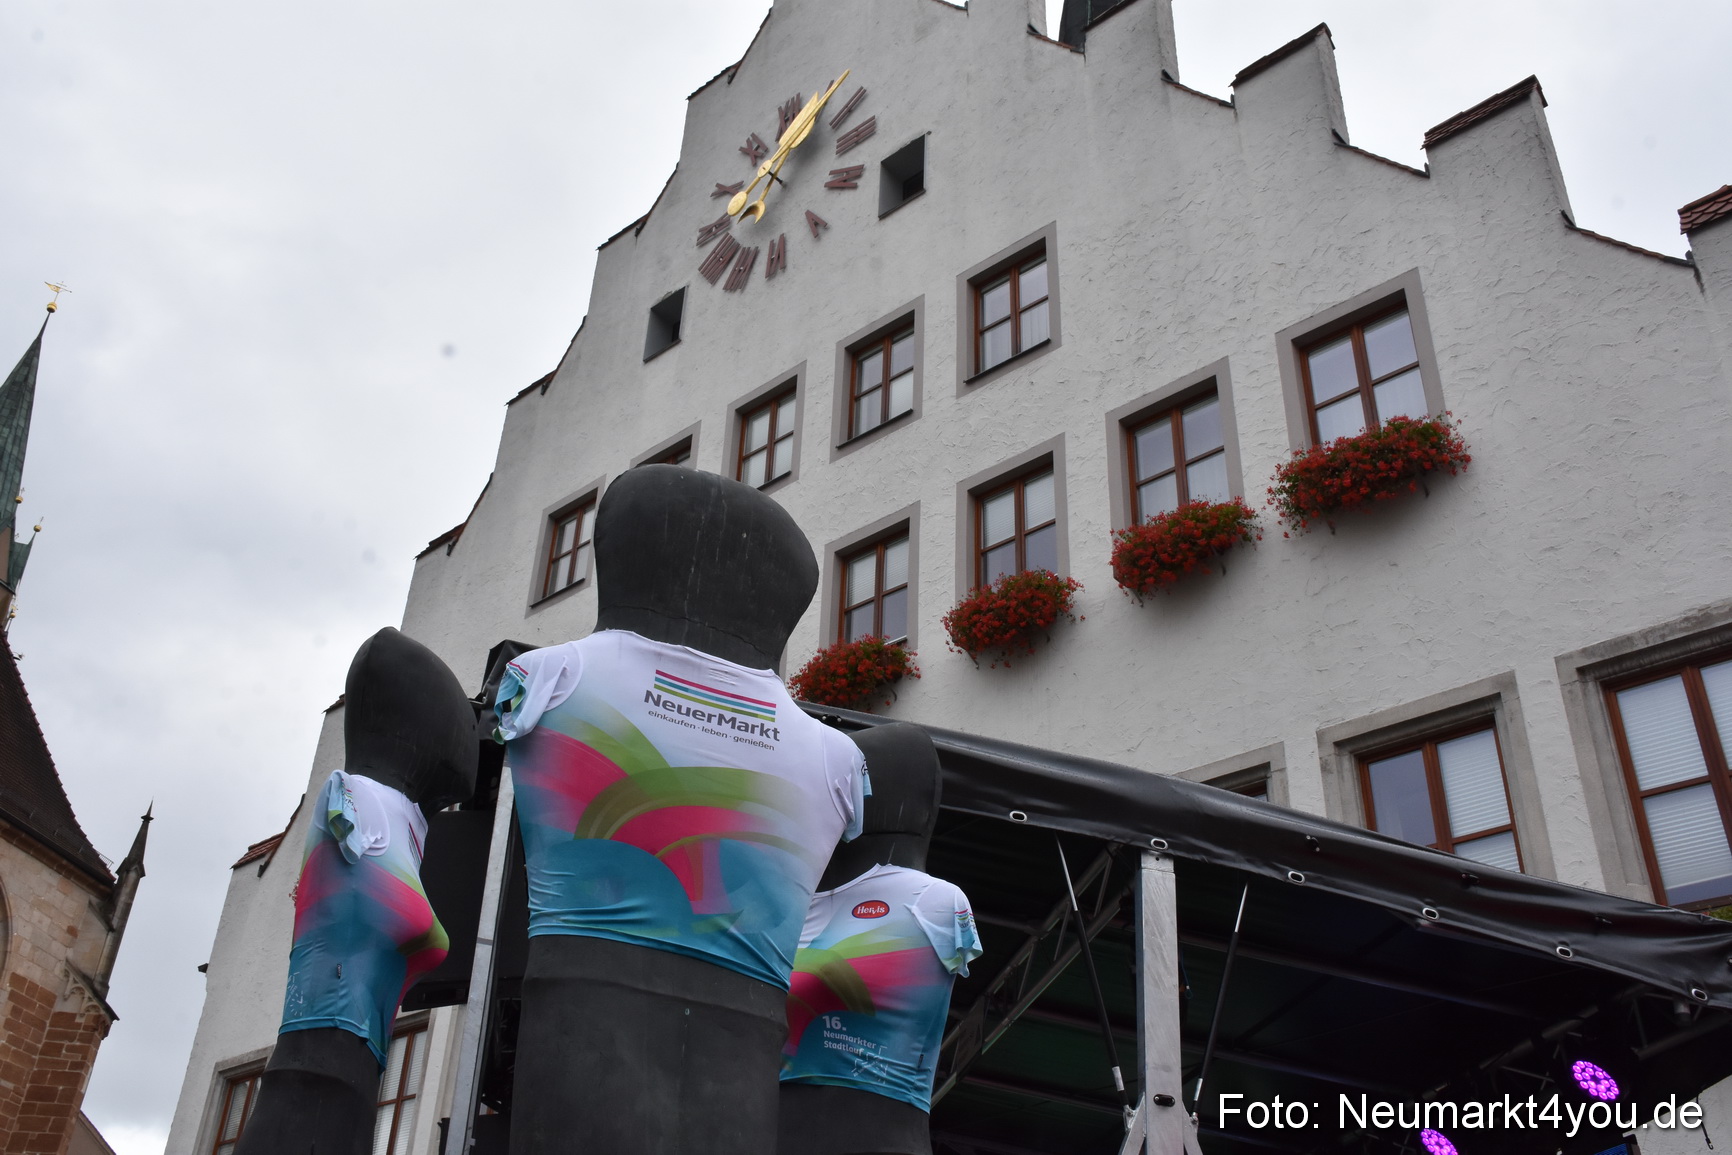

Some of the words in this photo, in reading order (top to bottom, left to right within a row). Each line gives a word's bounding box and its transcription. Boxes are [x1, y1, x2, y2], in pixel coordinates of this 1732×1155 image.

[644, 690, 780, 742] NeuerMarkt
[648, 709, 696, 730] einkaufen
[701, 726, 728, 739] leben
[733, 735, 775, 751] genießen
[822, 1015, 847, 1031] 16.
[823, 1030, 876, 1049] Neumarkter
[823, 1040, 865, 1056] Stadtlauf
